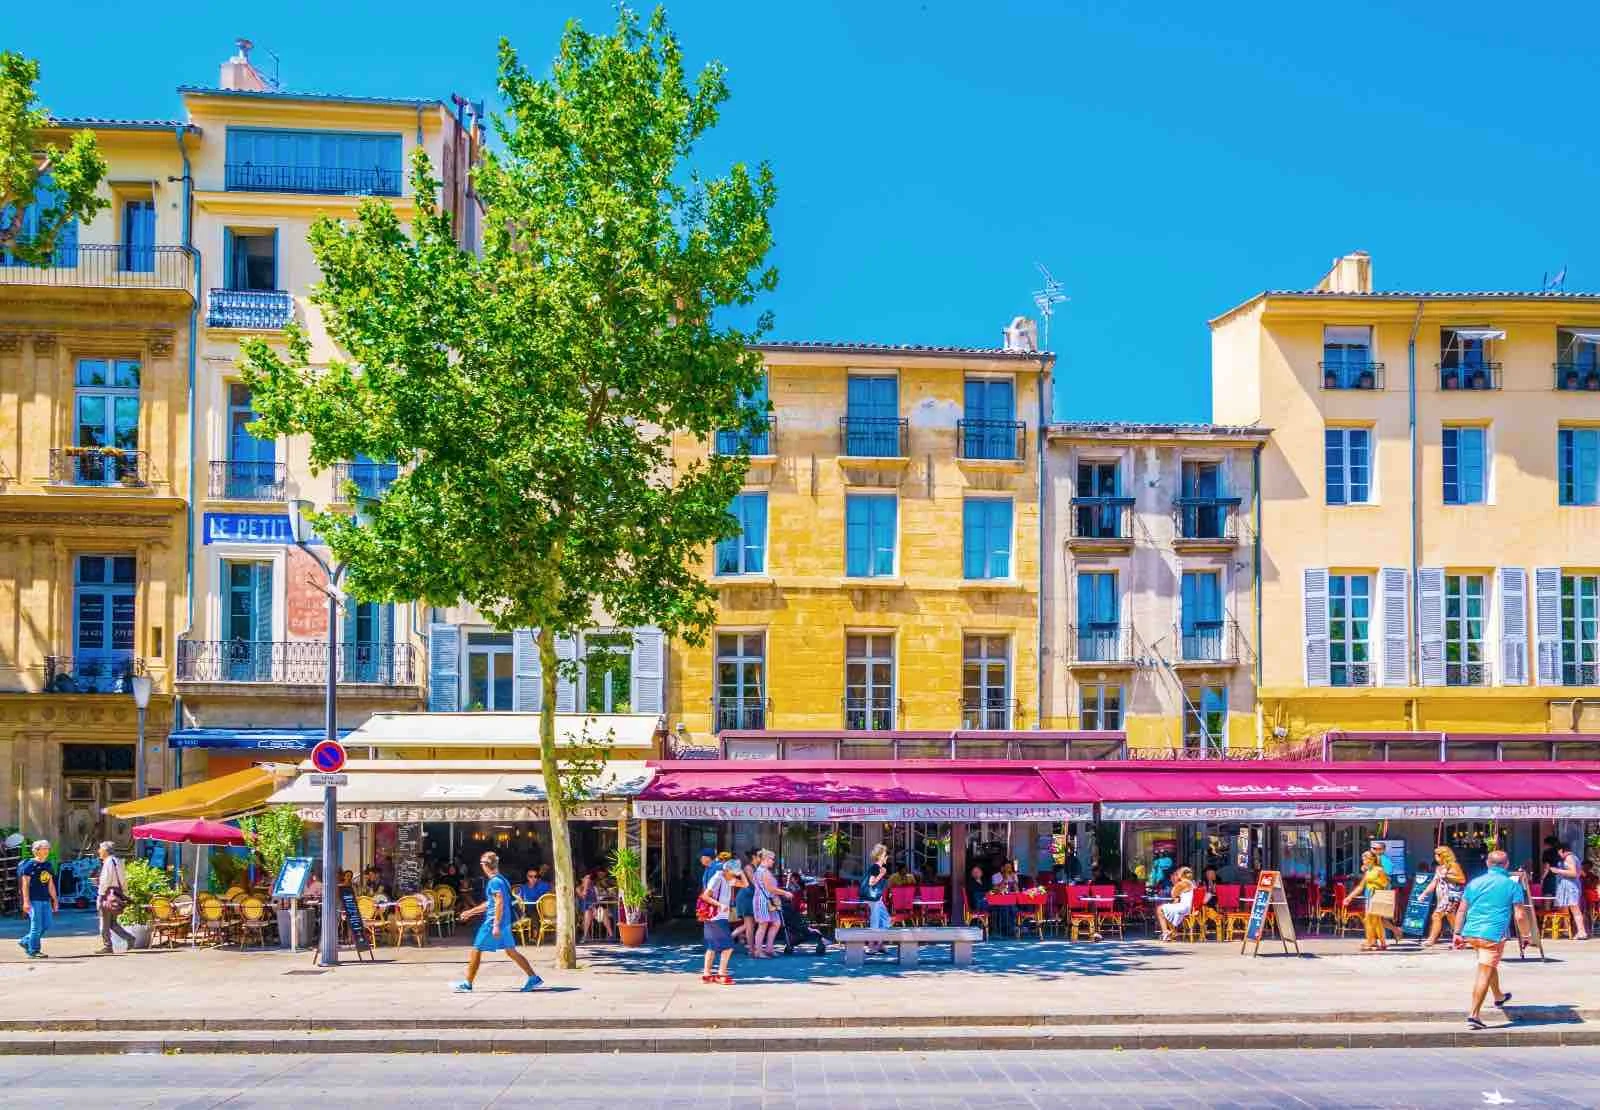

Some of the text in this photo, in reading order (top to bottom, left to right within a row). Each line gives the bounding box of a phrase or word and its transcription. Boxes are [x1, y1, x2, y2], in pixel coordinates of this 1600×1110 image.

[210, 517, 229, 539] LE
[237, 518, 288, 540] PETIT
[571, 805, 609, 817] Café
[641, 804, 728, 818] CHAMBRES
[730, 806, 745, 817] de
[748, 806, 817, 818] CHARME
[902, 807, 1085, 818] BRASSERIE RESTAURANT
